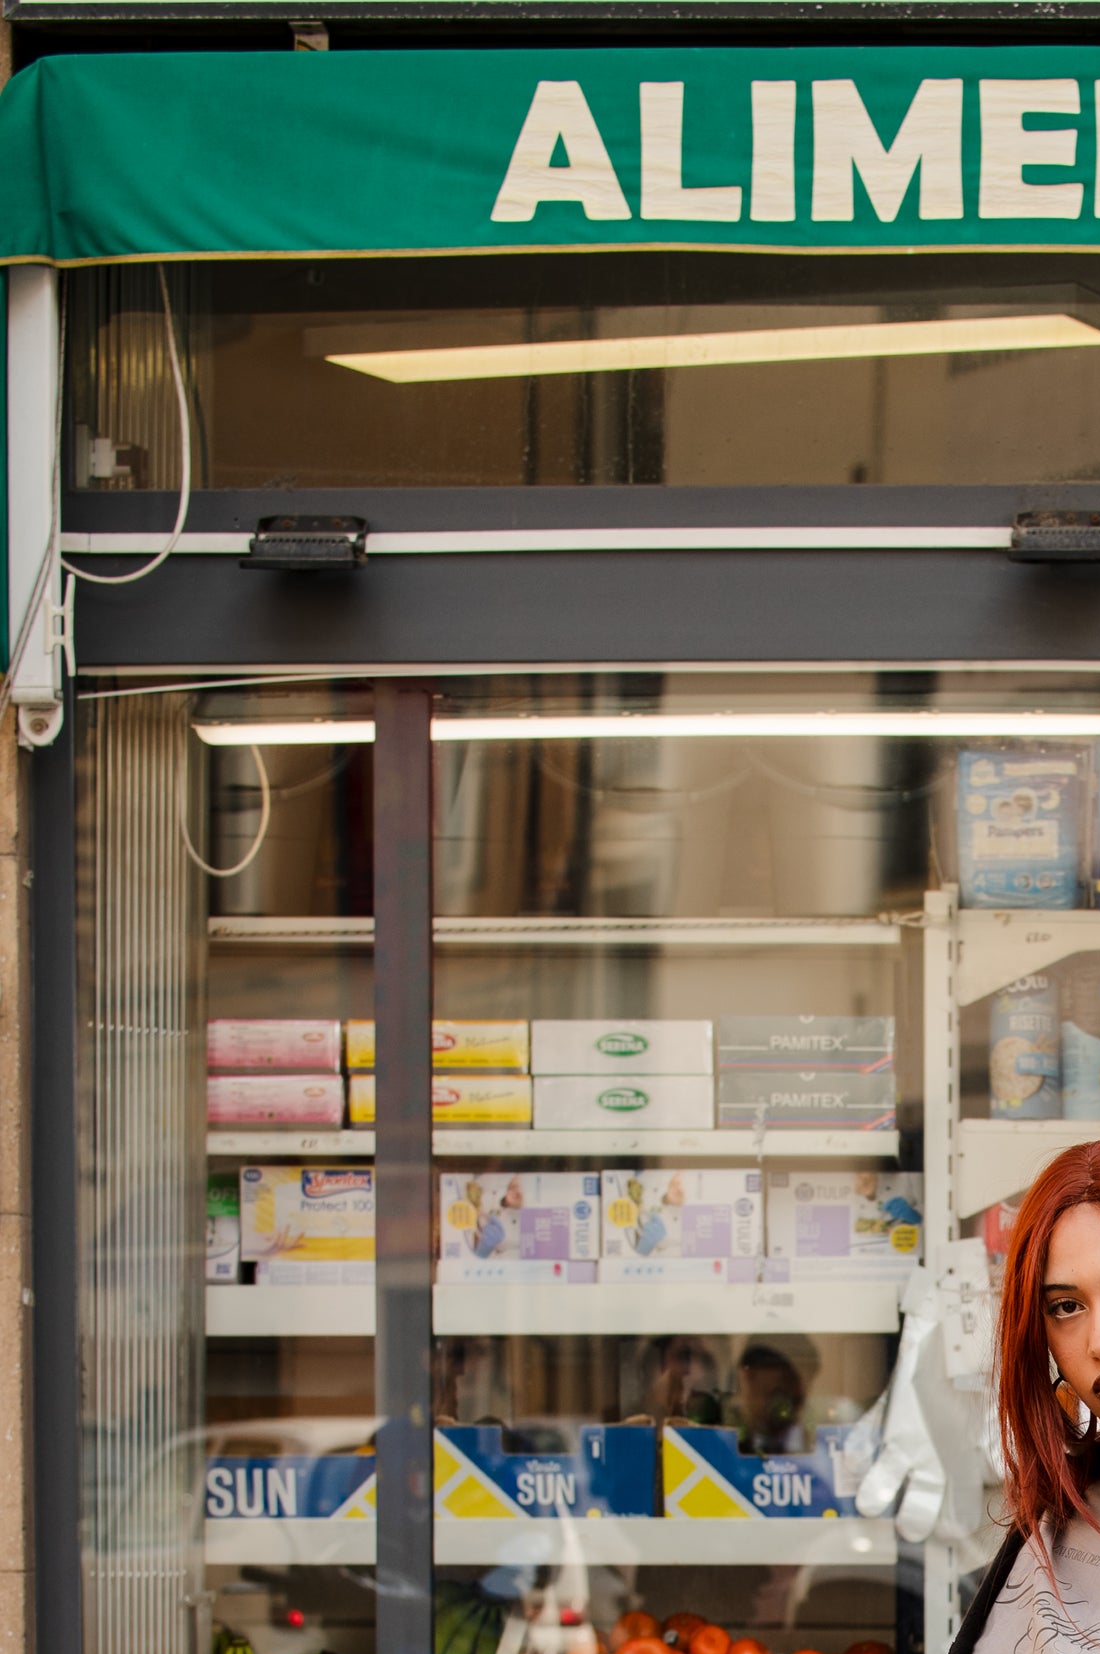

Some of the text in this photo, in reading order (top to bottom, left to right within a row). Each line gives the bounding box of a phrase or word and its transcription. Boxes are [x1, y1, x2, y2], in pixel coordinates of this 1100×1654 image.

[987, 824, 1044, 840] Pampers
[769, 1035, 843, 1051] PAMITEX
[770, 1092, 845, 1109] PAMITEX
[310, 1171, 370, 1189] Spontex
[816, 1185, 852, 1200] TULIP
[300, 1199, 374, 1212] Protect 100
[575, 1222, 590, 1257] TULIP
[206, 1467, 298, 1518] SUN
[516, 1472, 576, 1506] SUN
[752, 1474, 812, 1507] SUN
